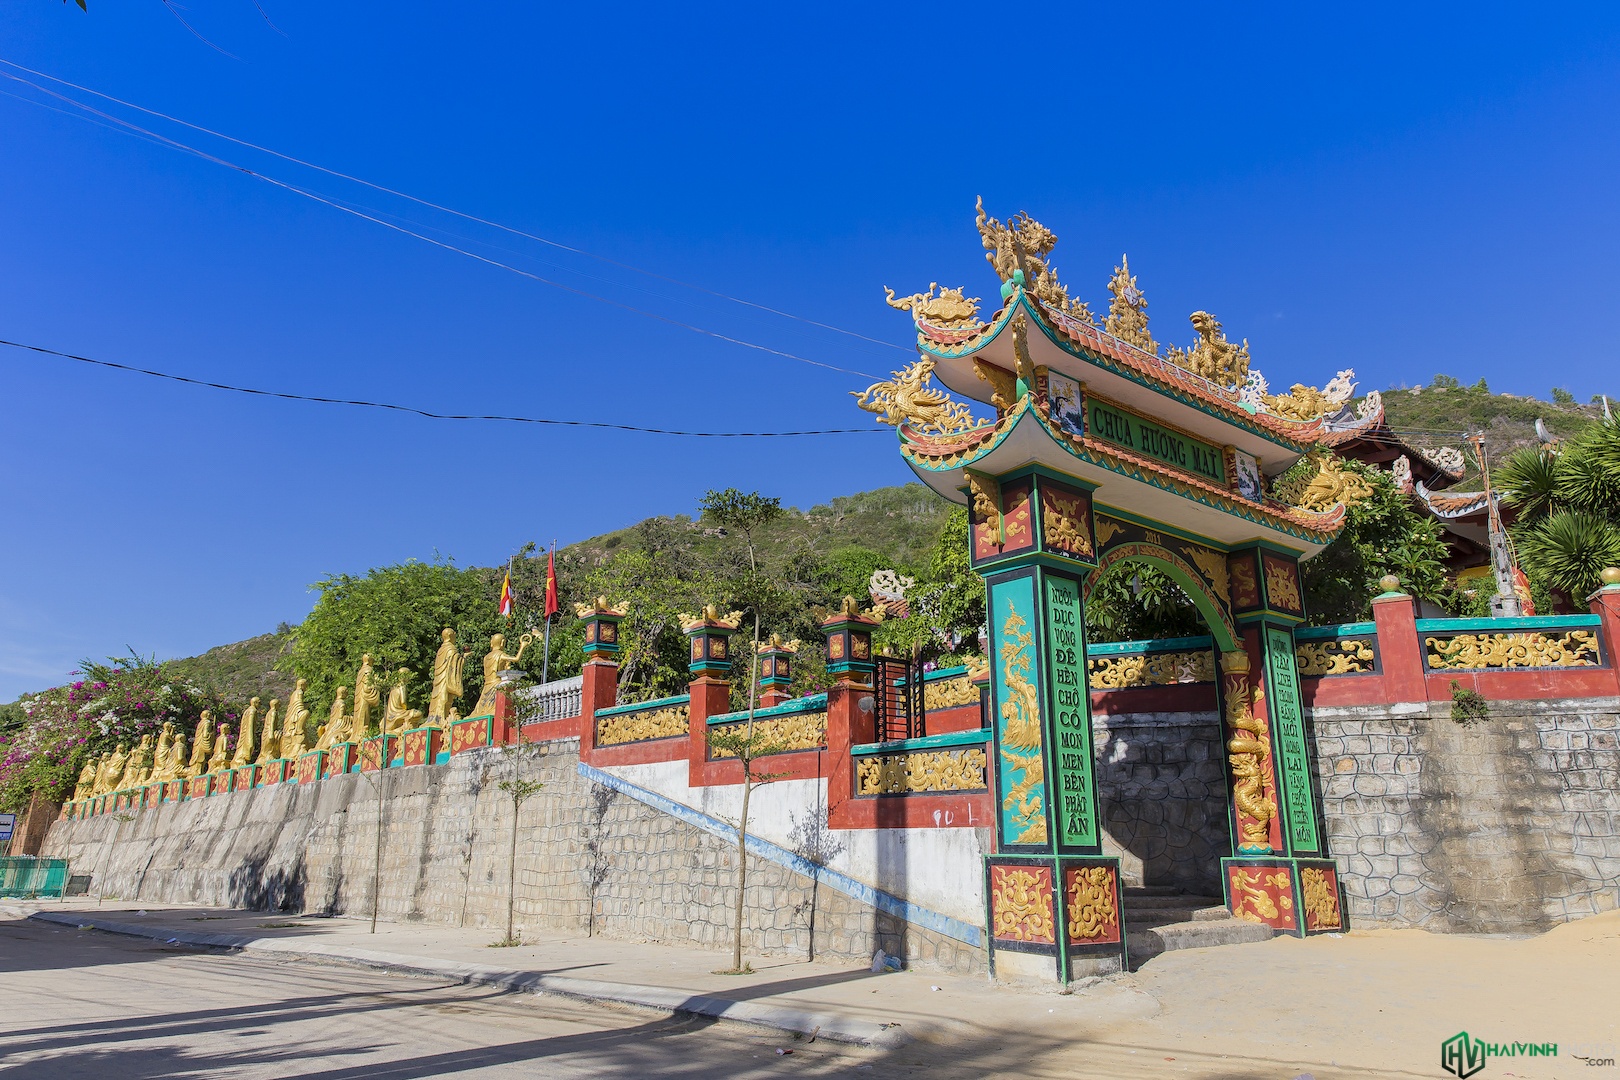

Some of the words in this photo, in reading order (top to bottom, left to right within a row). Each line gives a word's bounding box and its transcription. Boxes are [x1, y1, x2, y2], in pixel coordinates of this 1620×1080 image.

[1094, 407, 1134, 447] CHÙA
[1139, 424, 1187, 466] HƯƠNG
[1191, 445, 1219, 479] MAI
[1145, 530, 1162, 546] 2011
[1051, 587, 1073, 606] NUÔI
[1053, 608, 1075, 628] DỤC
[1054, 627, 1076, 647] VỌNG
[1057, 666, 1078, 686] HÈN
[1059, 708, 1081, 730] CÓ
[1276, 672, 1292, 688] LINH
[1286, 756, 1303, 772] LAI
[1060, 731, 1083, 750] MON
[1062, 753, 1084, 771] MEN
[1063, 771, 1085, 792] BÊN
[1064, 793, 1087, 817] PHẬT
